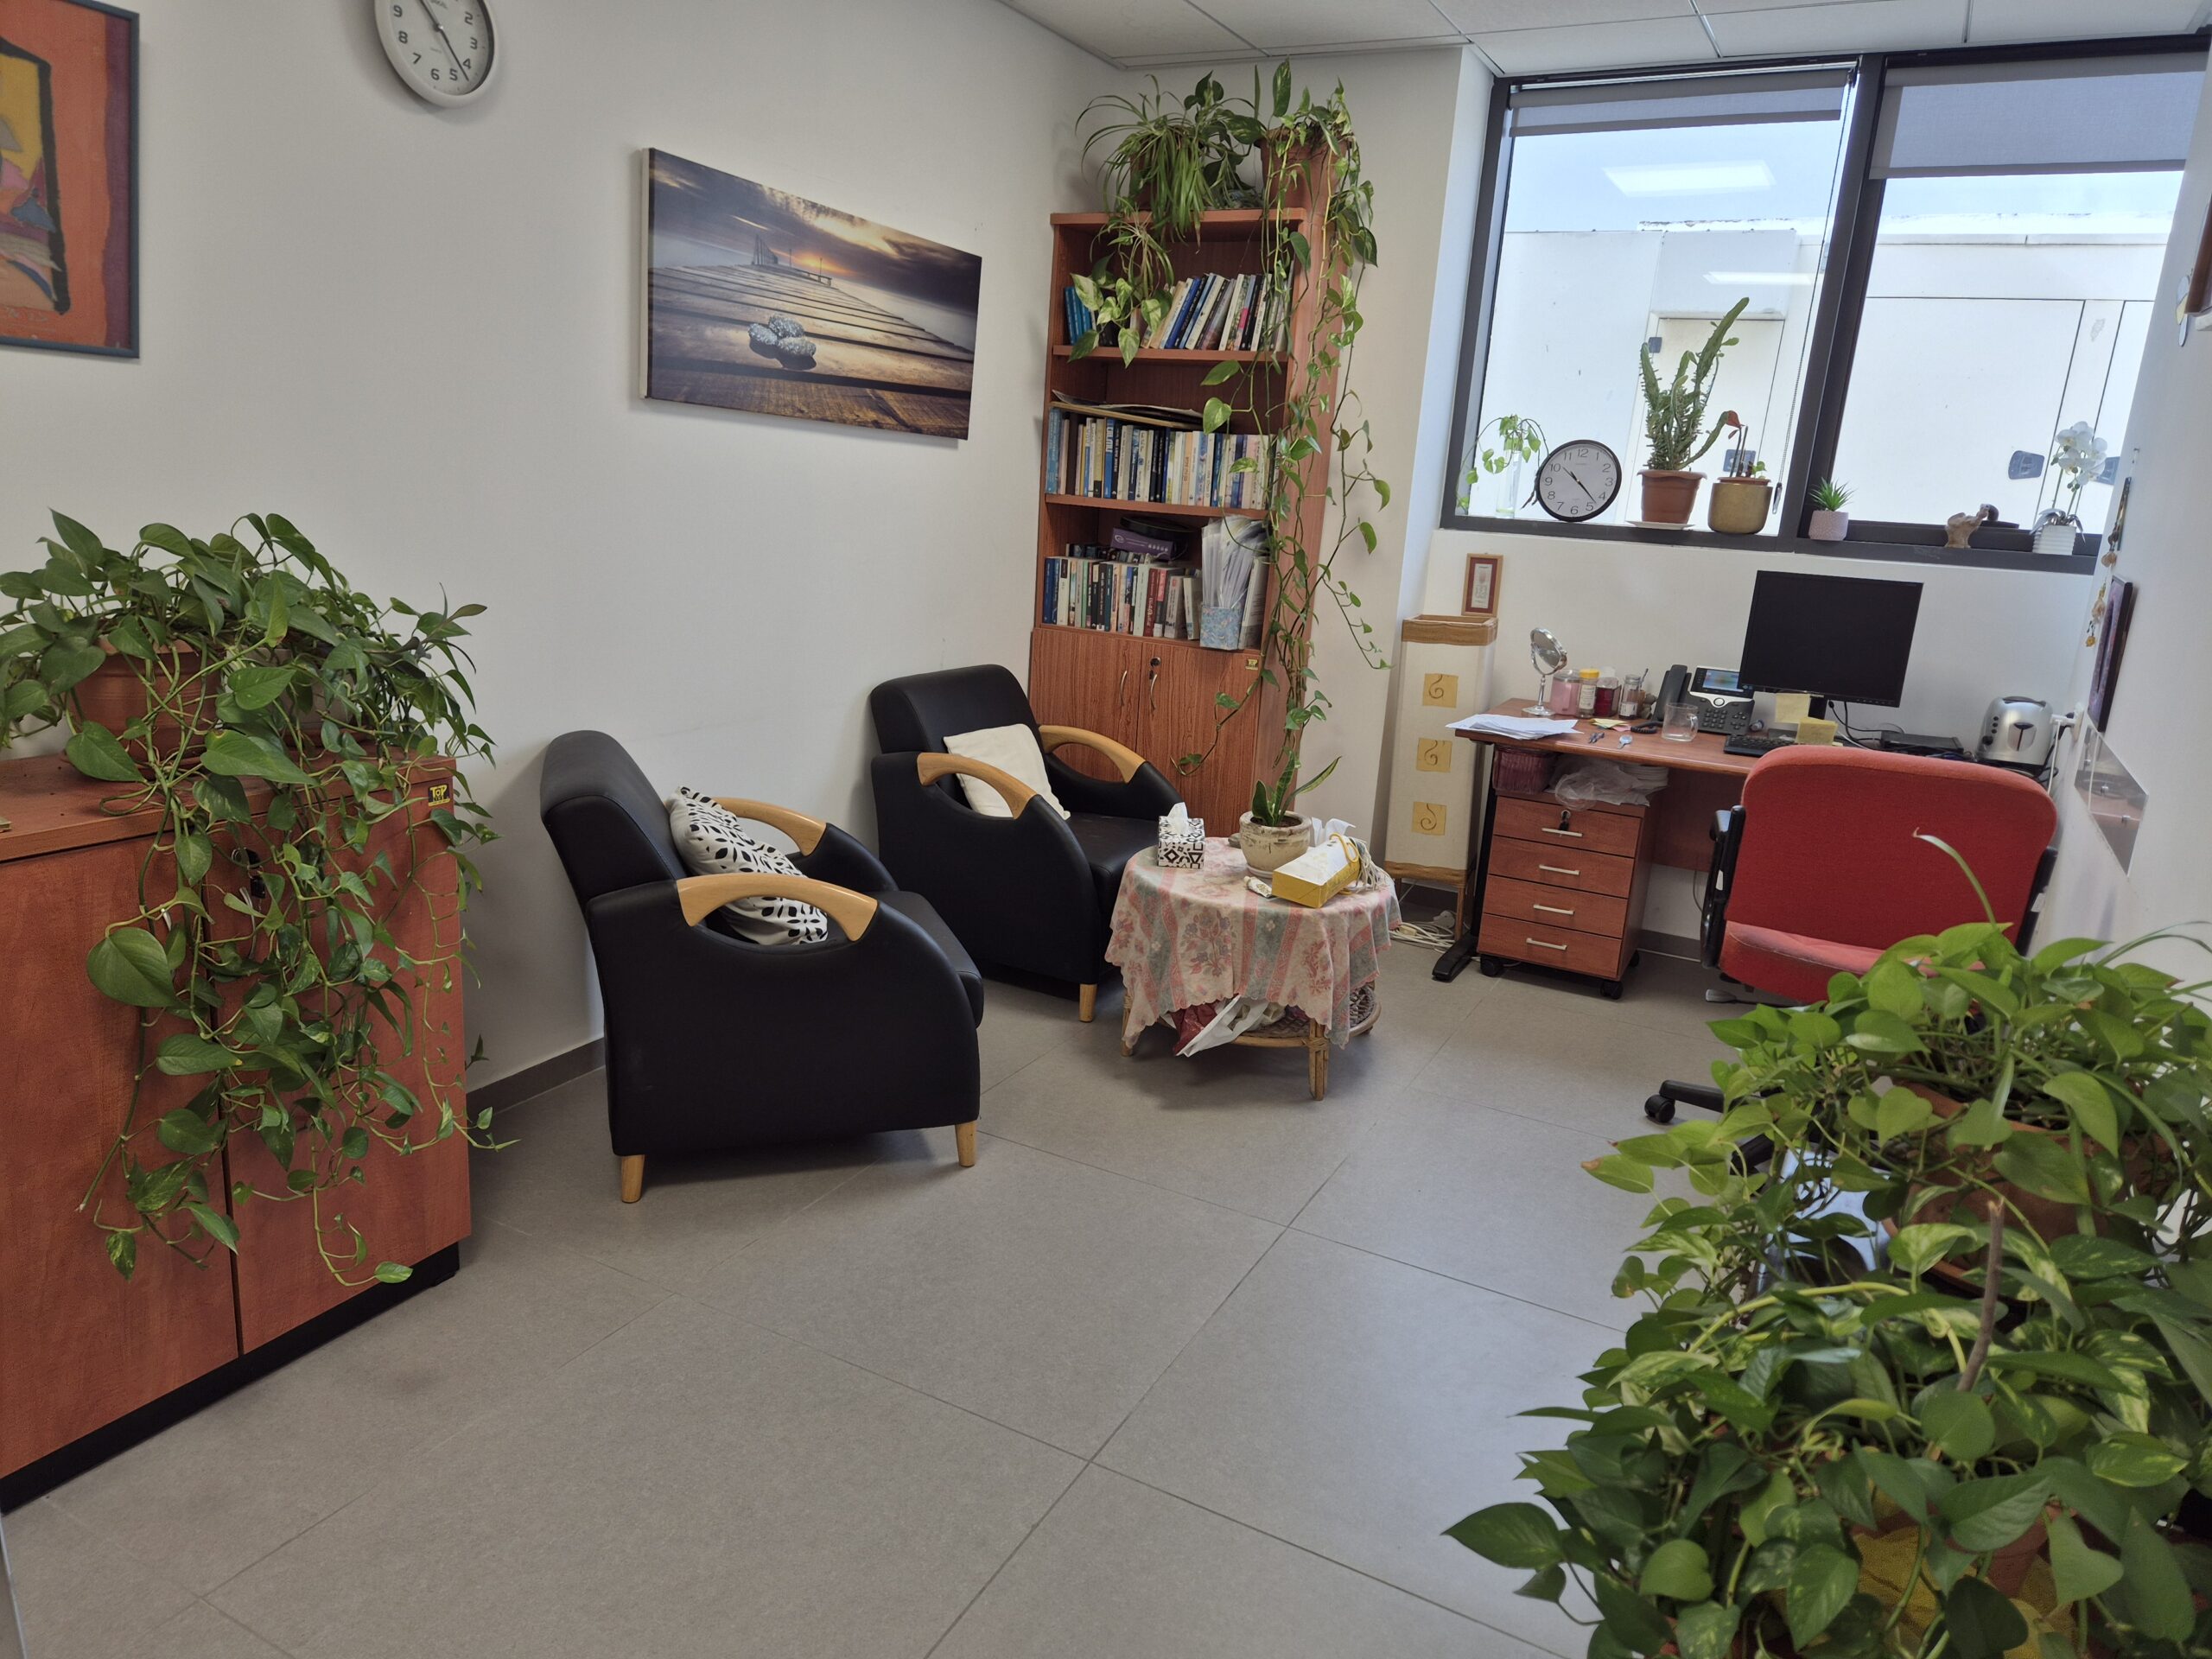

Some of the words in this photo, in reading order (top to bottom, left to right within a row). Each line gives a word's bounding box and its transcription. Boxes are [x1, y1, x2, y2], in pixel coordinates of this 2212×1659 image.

[393, 5, 403, 17] 9
[464, 11, 474, 25] 2
[398, 30, 408, 44] 8
[470, 37, 478, 50] 3
[412, 52, 422, 65] 7
[462, 58, 472, 70] 4
[430, 68, 440, 80] 6
[449, 68, 458, 81] 5
[1564, 452, 1572, 461] 11
[1578, 448, 1589, 458] 12
[1596, 452, 1599, 461] 1
[1550, 463, 1561, 473] 10
[1602, 463, 1611, 473] 2
[1545, 477, 1553, 486] 9
[1605, 477, 1613, 486] 3
[1547, 491, 1555, 500] 8
[1599, 492, 1605, 500] 4
[1557, 502, 1564, 511] 7
[1570, 505, 1579, 515] 6
[1586, 502, 1594, 512] 5
